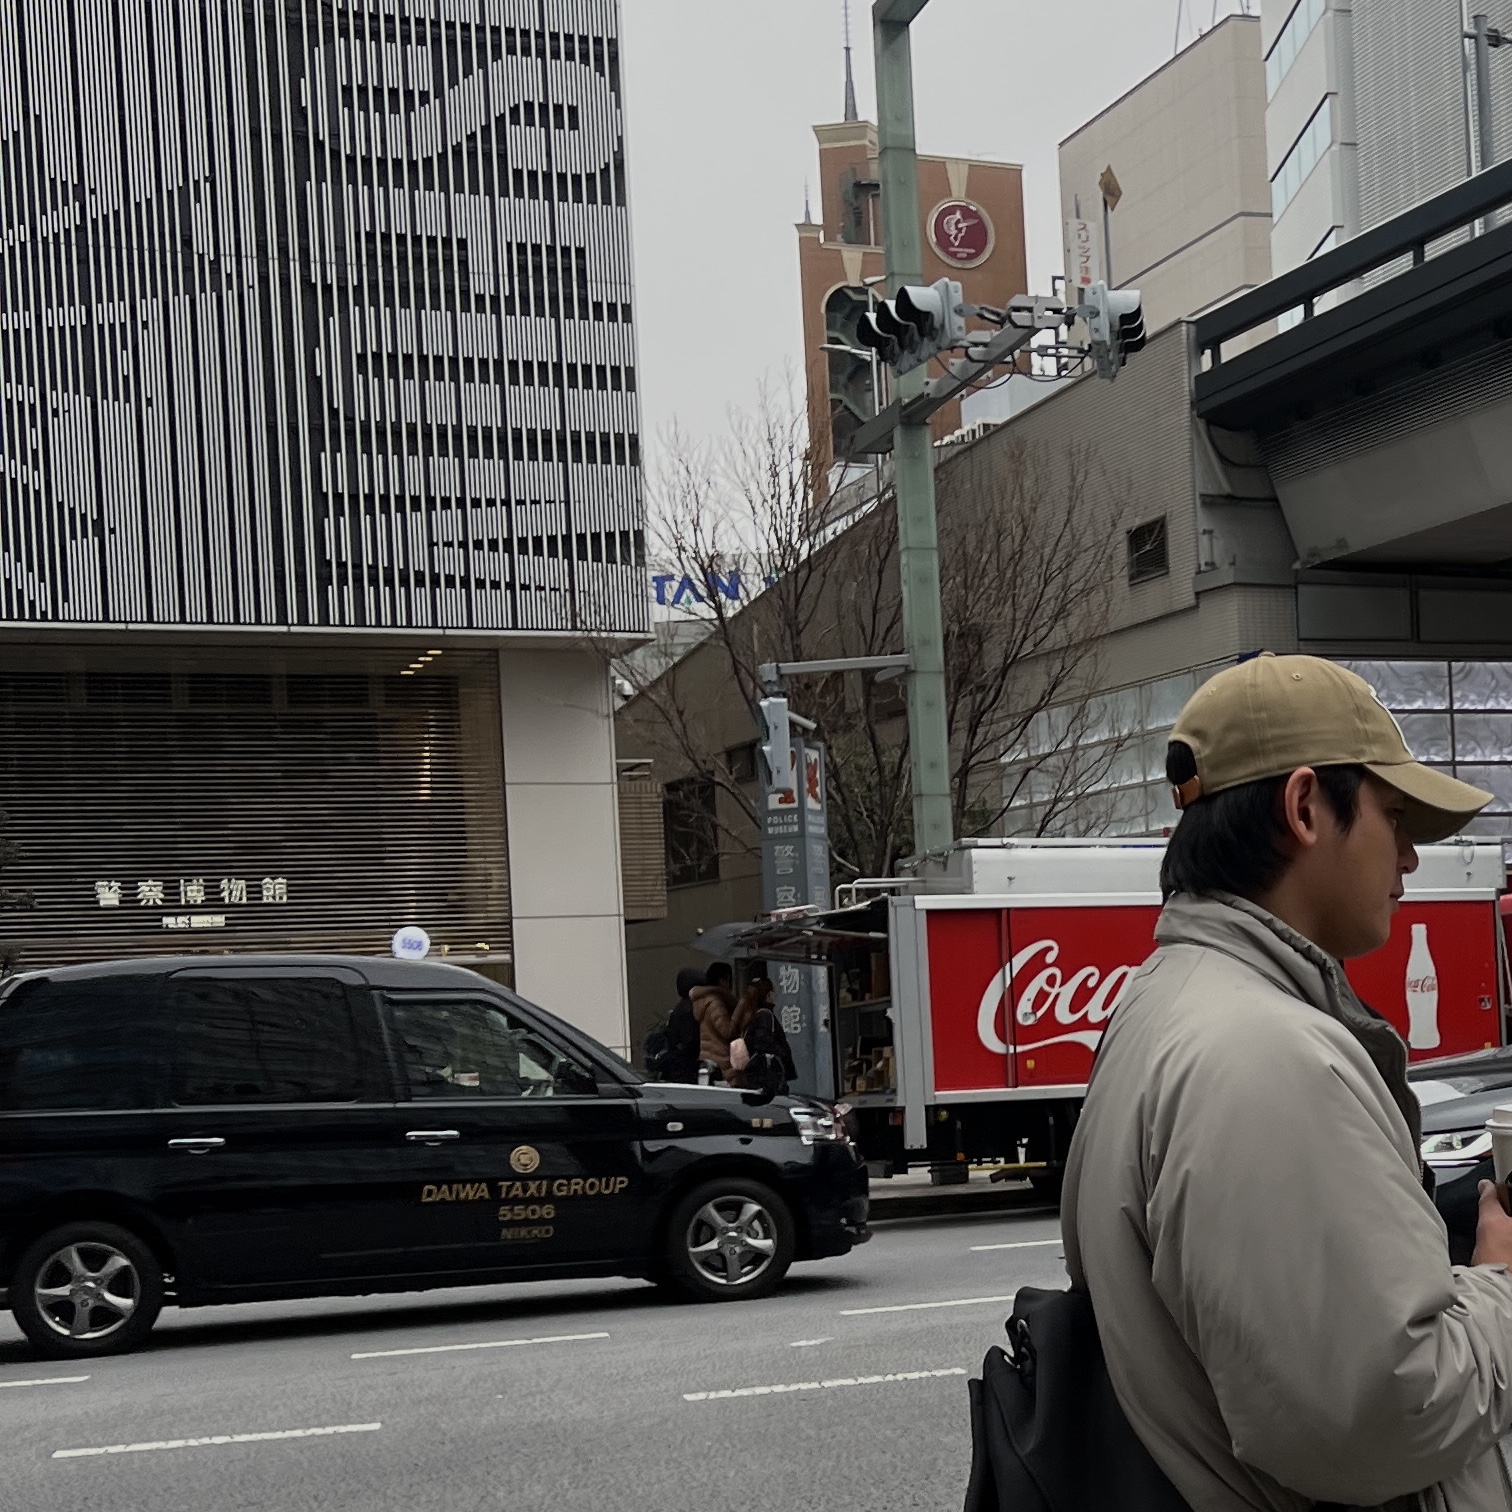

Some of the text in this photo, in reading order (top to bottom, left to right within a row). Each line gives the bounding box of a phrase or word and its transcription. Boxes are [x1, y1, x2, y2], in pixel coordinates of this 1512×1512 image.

[300, 0, 648, 630] SEUM
[95, 877, 288, 907] 警察博物館
[421, 1176, 629, 1203] DAIWA TAXI GROUP
[498, 1204, 555, 1221] 5506
[501, 1225, 554, 1240] NIKKO
